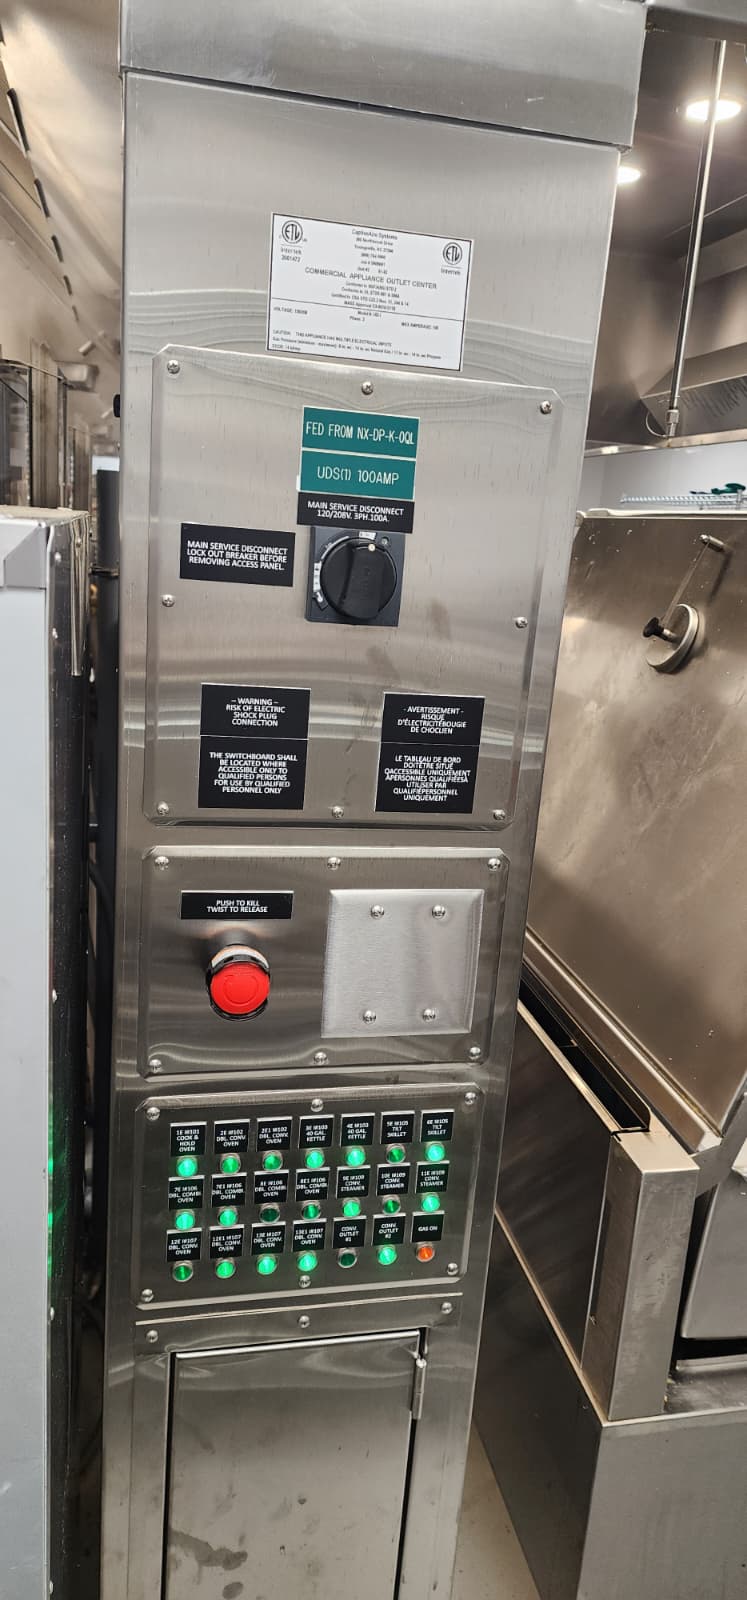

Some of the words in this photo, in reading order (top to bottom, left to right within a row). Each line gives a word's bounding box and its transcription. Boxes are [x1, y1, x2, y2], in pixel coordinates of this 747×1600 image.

[305, 267, 347, 278] COMMERCIAL
[349, 273, 384, 282] APPLIANCE
[387, 278, 410, 286] OUTLET
[306, 421, 324, 436] FED
[328, 424, 353, 439] FROM
[317, 466, 351, 481] UDS(1)
[358, 470, 399, 485] 100AMP
[308, 501, 327, 509] MAIN
[330, 502, 357, 512] SERVICE
[360, 505, 404, 515] DISCONNECT
[188, 540, 209, 549] MAIN
[210, 541, 240, 552] SERVICE
[241, 544, 288, 555] DISCONNECT
[187, 549, 206, 557] LOCK
[207, 550, 224, 558] OUT
[226, 551, 258, 561] BREAKER
[260, 553, 287, 563] BEFORE
[189, 556, 230, 567] REMOVING
[232, 559, 259, 569] ACCESS
[260, 561, 284, 570] PANEL.
[407, 706, 460, 714] AVERTISSEMENT
[224, 752, 275, 760] SWITCHBOARD
